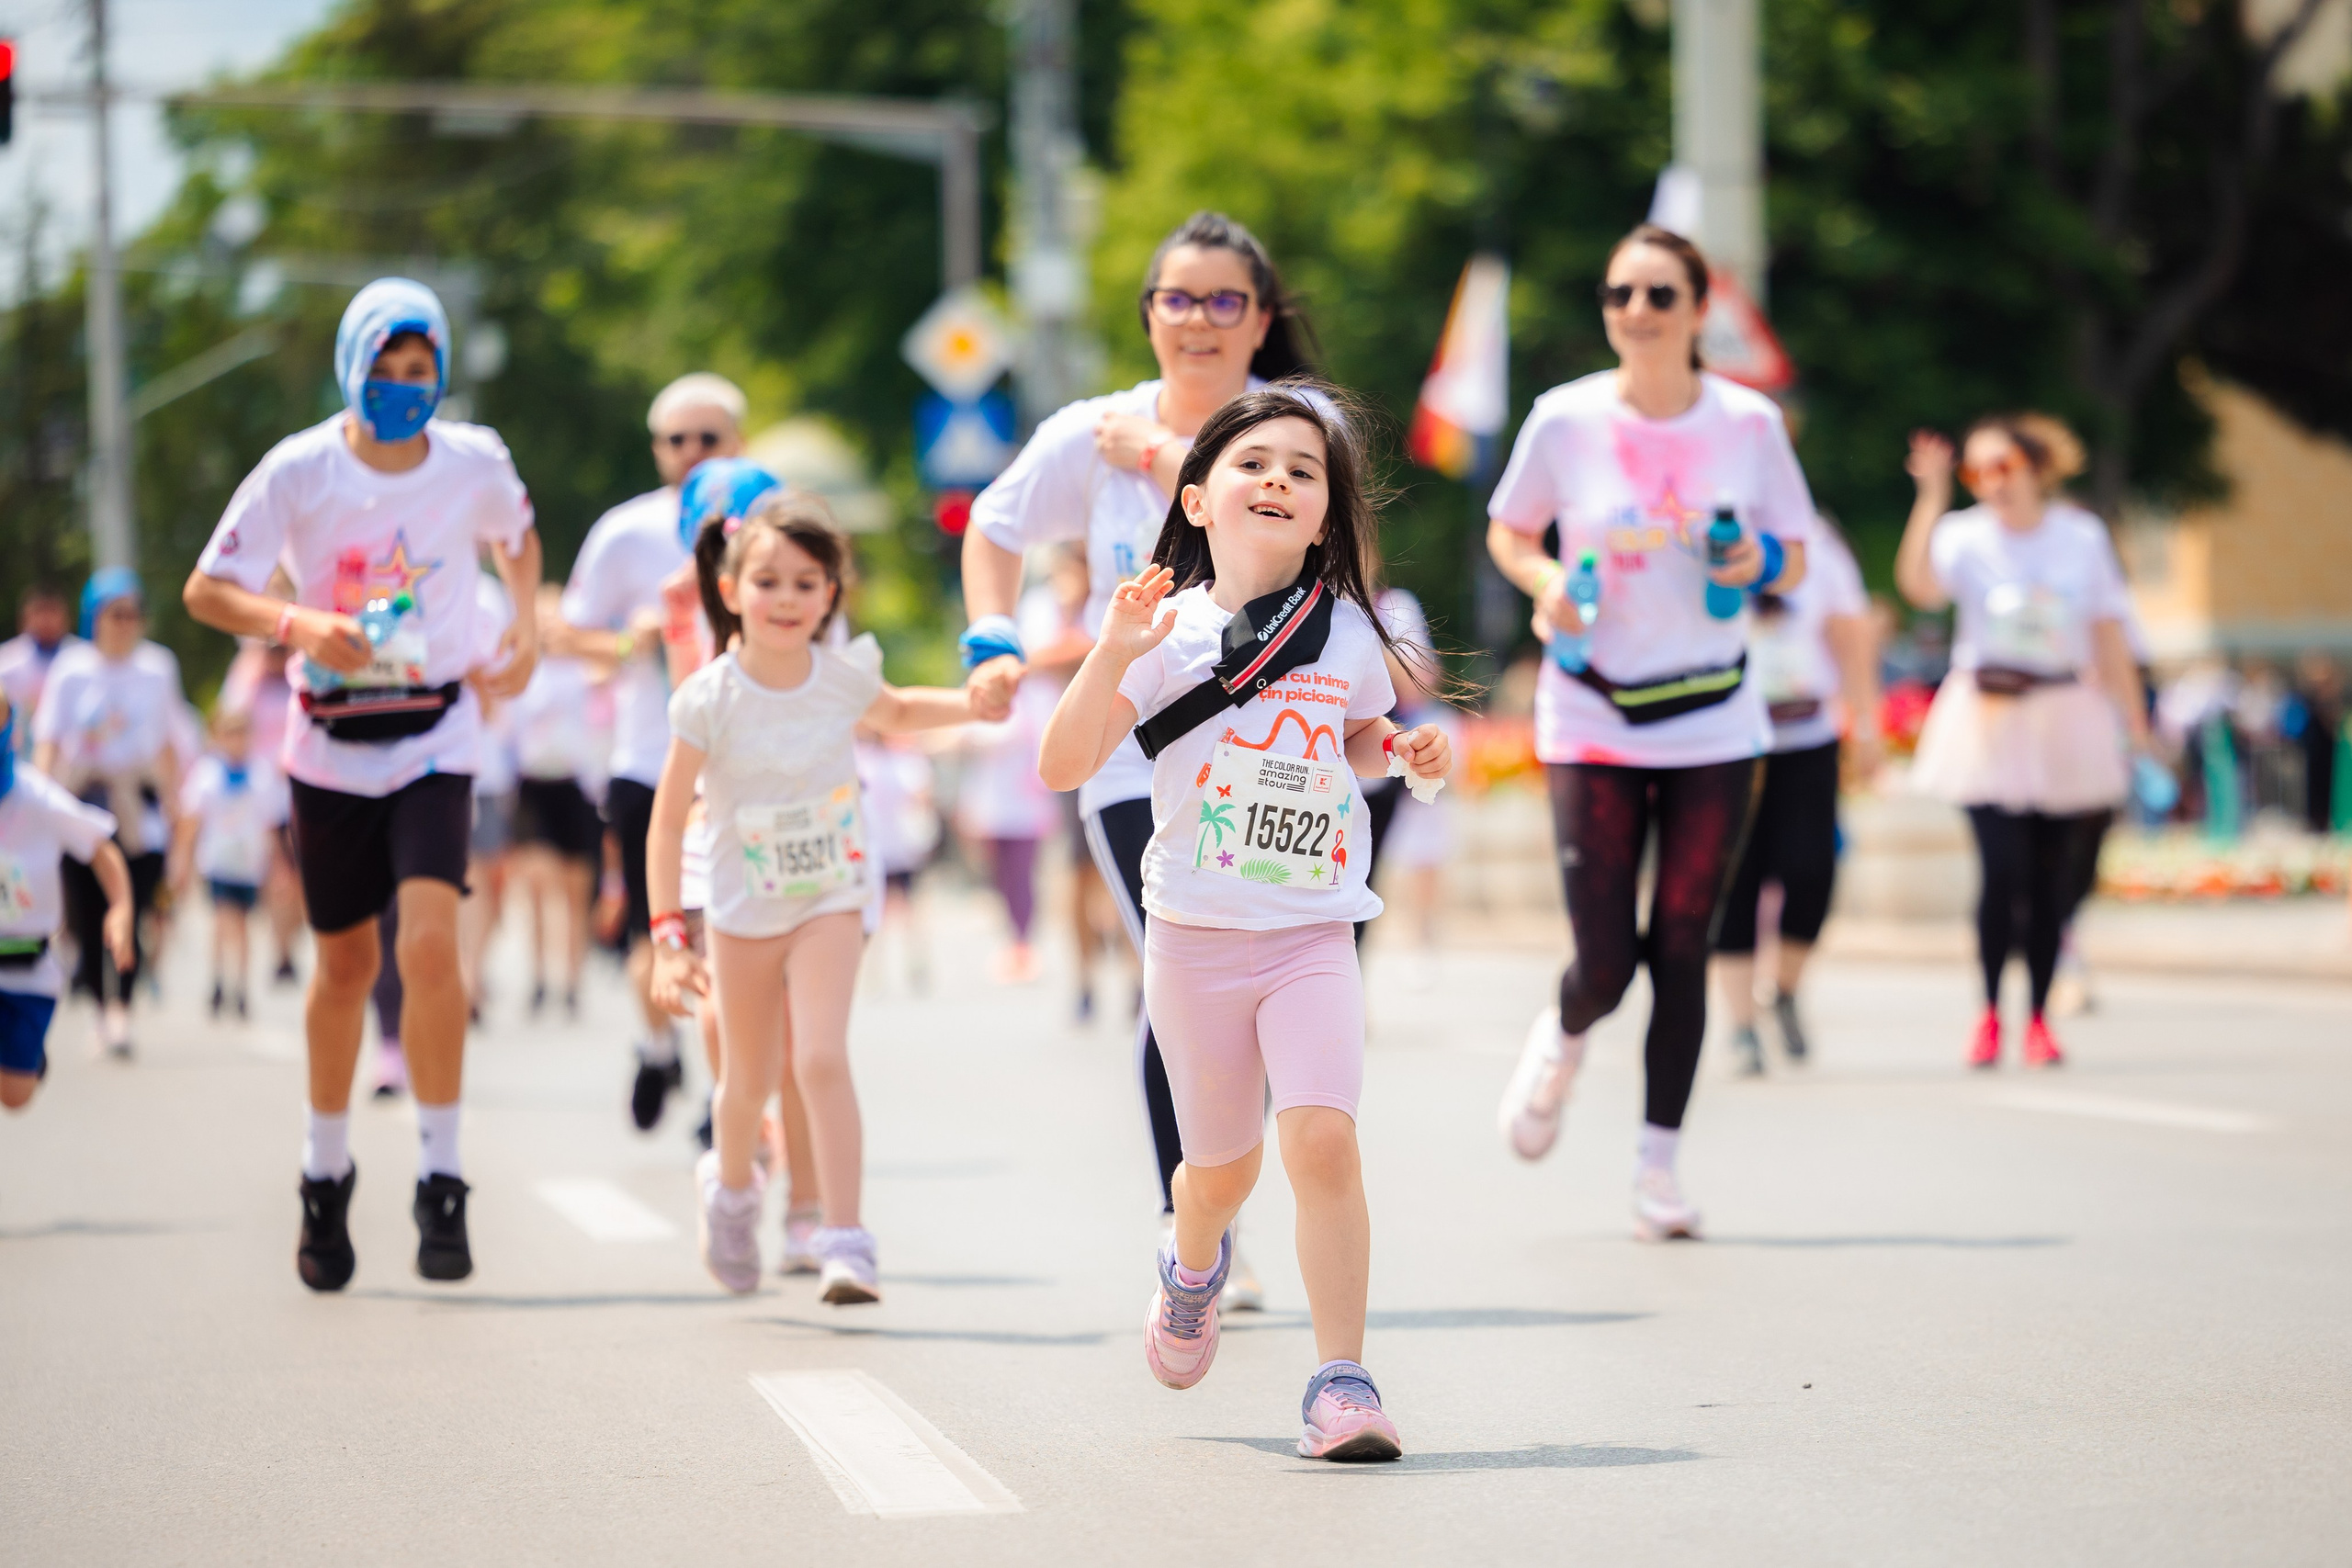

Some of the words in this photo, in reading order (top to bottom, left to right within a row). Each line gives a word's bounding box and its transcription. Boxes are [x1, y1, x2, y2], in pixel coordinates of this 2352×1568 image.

[1263, 602, 1295, 634] UniCredit
[1288, 586, 1306, 605] Bank
[1290, 672, 1311, 683] cu
[1314, 671, 1350, 691] inima
[1262, 758, 1273, 769] THE
[1274, 761, 1295, 773] COLOR
[1259, 769, 1306, 785] amazing
[1265, 777, 1286, 789] tour
[1245, 802, 1330, 857] 15522
